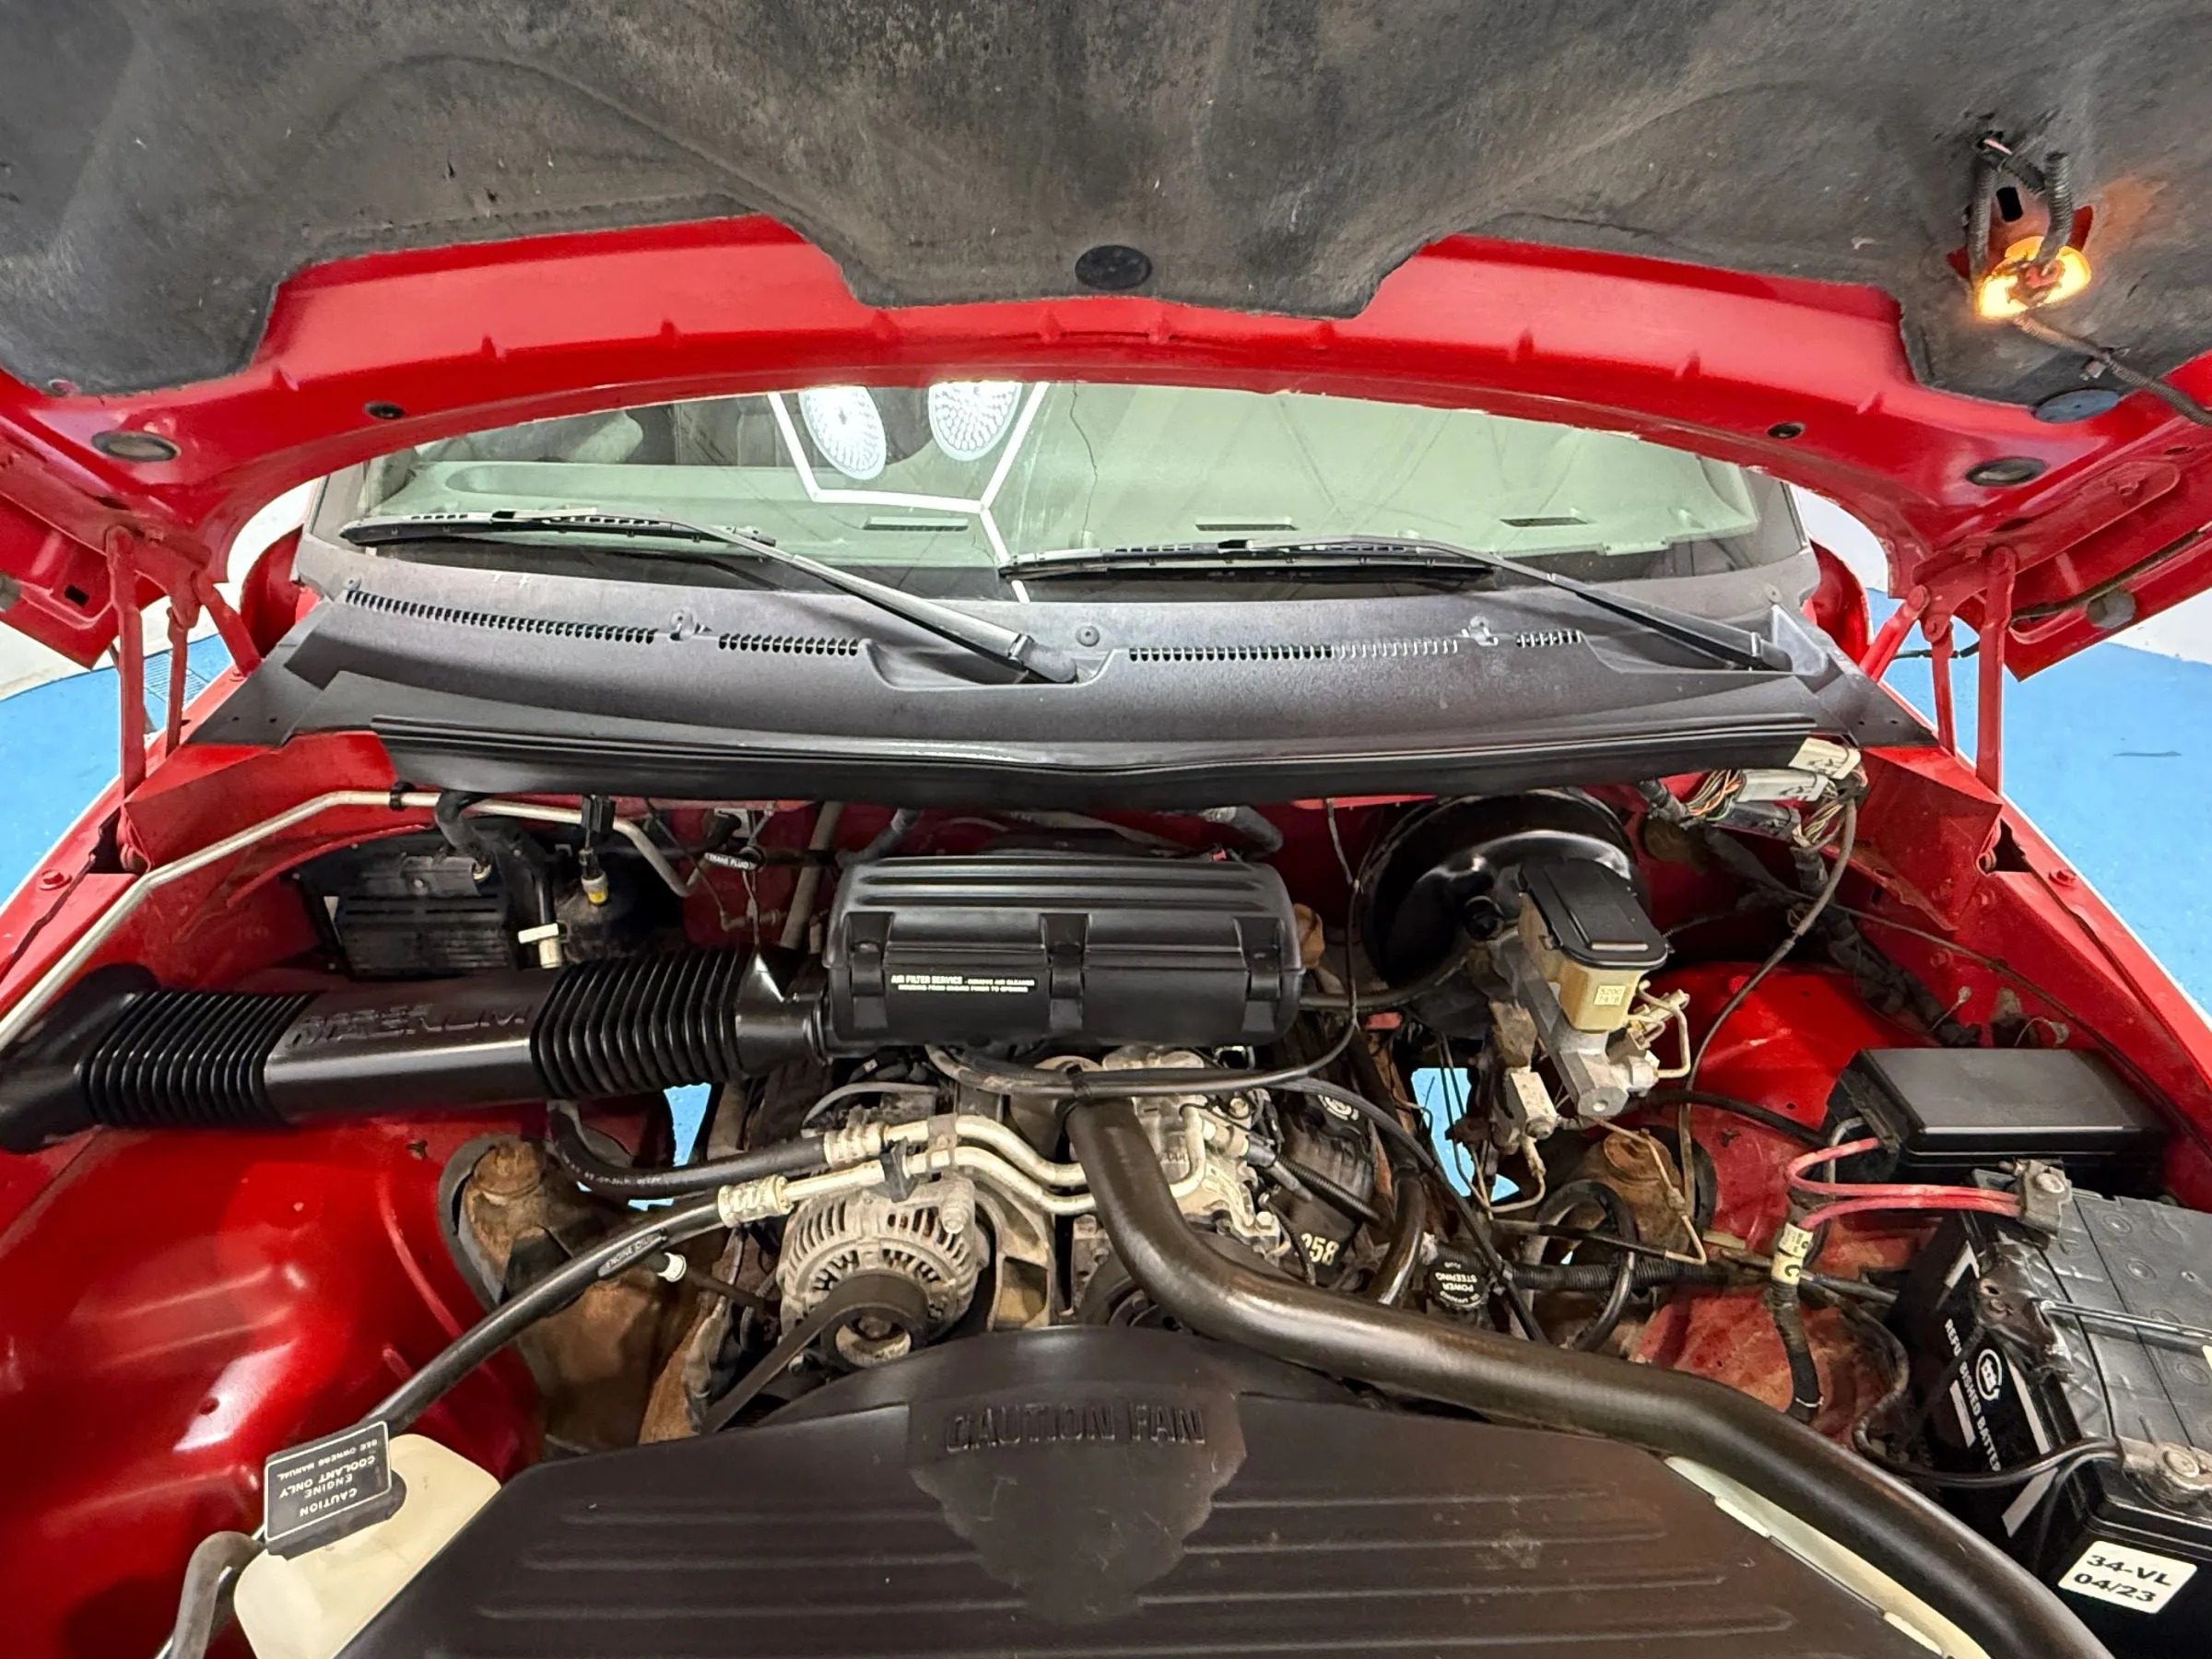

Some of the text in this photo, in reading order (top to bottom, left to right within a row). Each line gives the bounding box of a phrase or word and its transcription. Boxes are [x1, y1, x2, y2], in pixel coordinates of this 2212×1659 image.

[890, 975, 904, 983] AIR
[906, 975, 930, 984] FILTER
[932, 975, 963, 984] SERVICE
[1435, 1272, 1477, 1283] STEERING
[1441, 1281, 1475, 1292] POWER
[1944, 1318, 2001, 1472] REFUBISHED BATTER
[947, 1402, 1206, 1453] CAUTION FAN
[359, 1439, 378, 1452] SEE
[276, 1463, 315, 1481] MANUAL
[278, 1455, 376, 1500] COOLANT ONLY
[304, 1473, 353, 1499] ENGINE
[299, 1488, 358, 1517] CAUTION
[2087, 1554, 2172, 1587] 34-VL
[2074, 1573, 2157, 1602] 04/23
